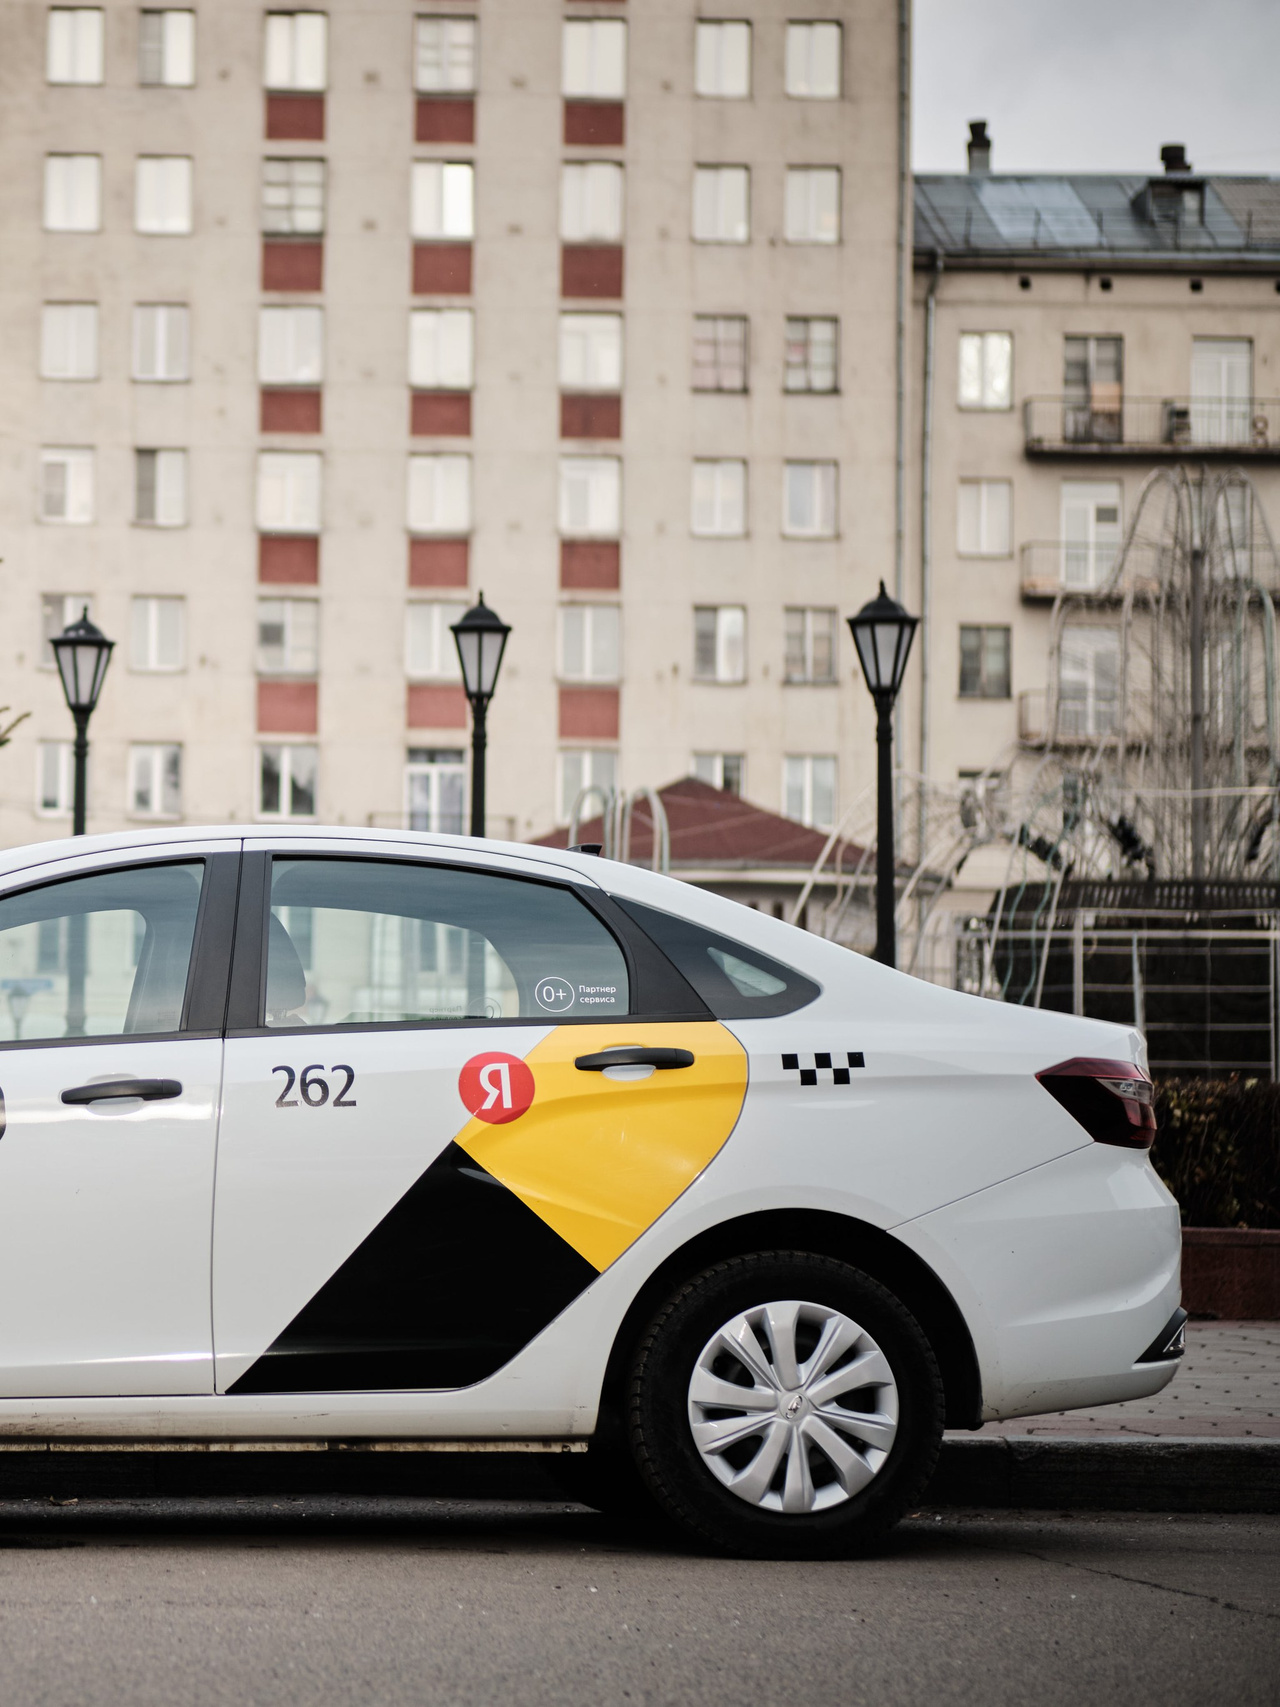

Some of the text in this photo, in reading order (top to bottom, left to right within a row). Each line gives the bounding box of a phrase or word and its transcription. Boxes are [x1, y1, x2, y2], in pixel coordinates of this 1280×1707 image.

[543, 985, 567, 1003] 0+
[578, 985, 617, 995] Партнер
[579, 996, 616, 1005] сервиса
[271, 1064, 357, 1108] 262
[479, 1062, 513, 1110] Я
